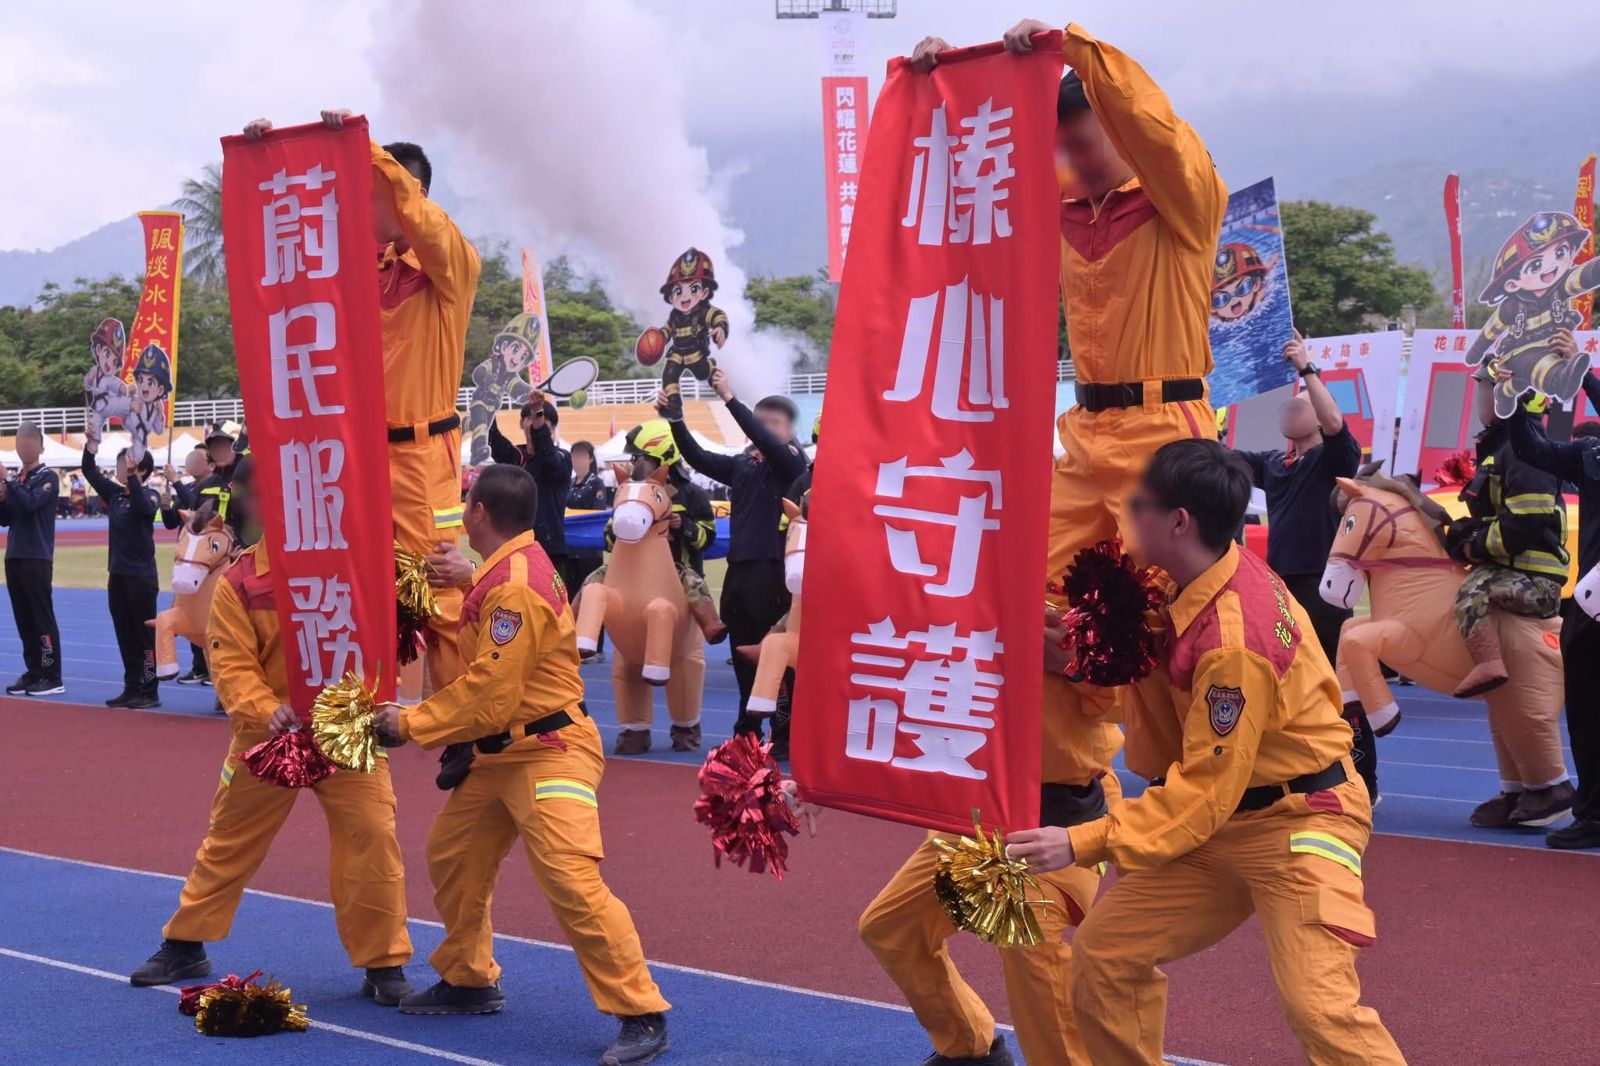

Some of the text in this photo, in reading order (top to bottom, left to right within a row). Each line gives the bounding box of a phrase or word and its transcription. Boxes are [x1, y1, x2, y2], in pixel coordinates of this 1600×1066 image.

[40, 634, 54, 668] FILA
[258, 162, 365, 687] 蔚民服務
[845, 96, 1015, 780] 榛心守護
